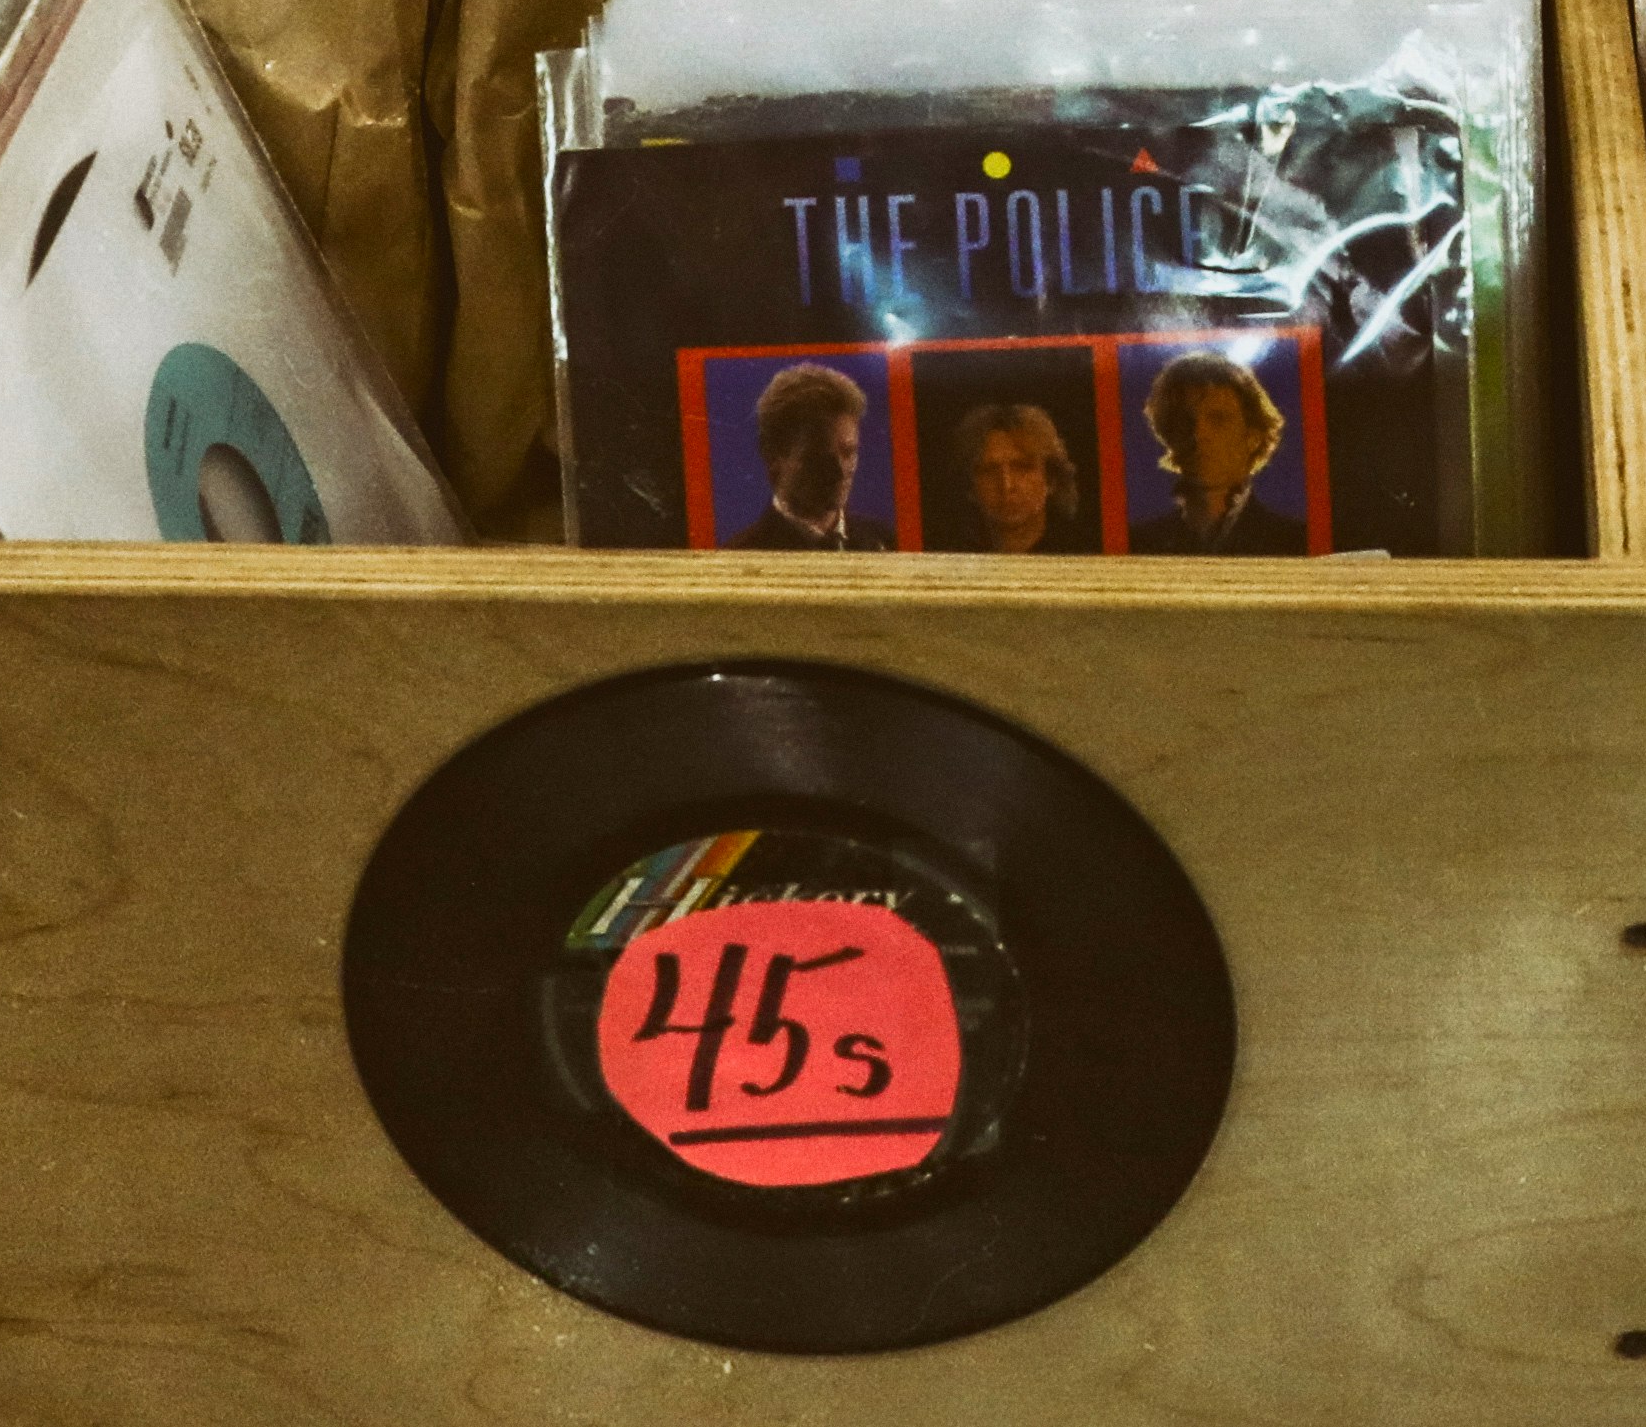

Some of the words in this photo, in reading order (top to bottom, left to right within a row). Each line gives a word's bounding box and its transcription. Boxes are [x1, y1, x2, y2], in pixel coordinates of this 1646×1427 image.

[782, 191, 918, 308] THE
[952, 182, 1224, 303] POLICE
[631, 941, 894, 1114] 45s
